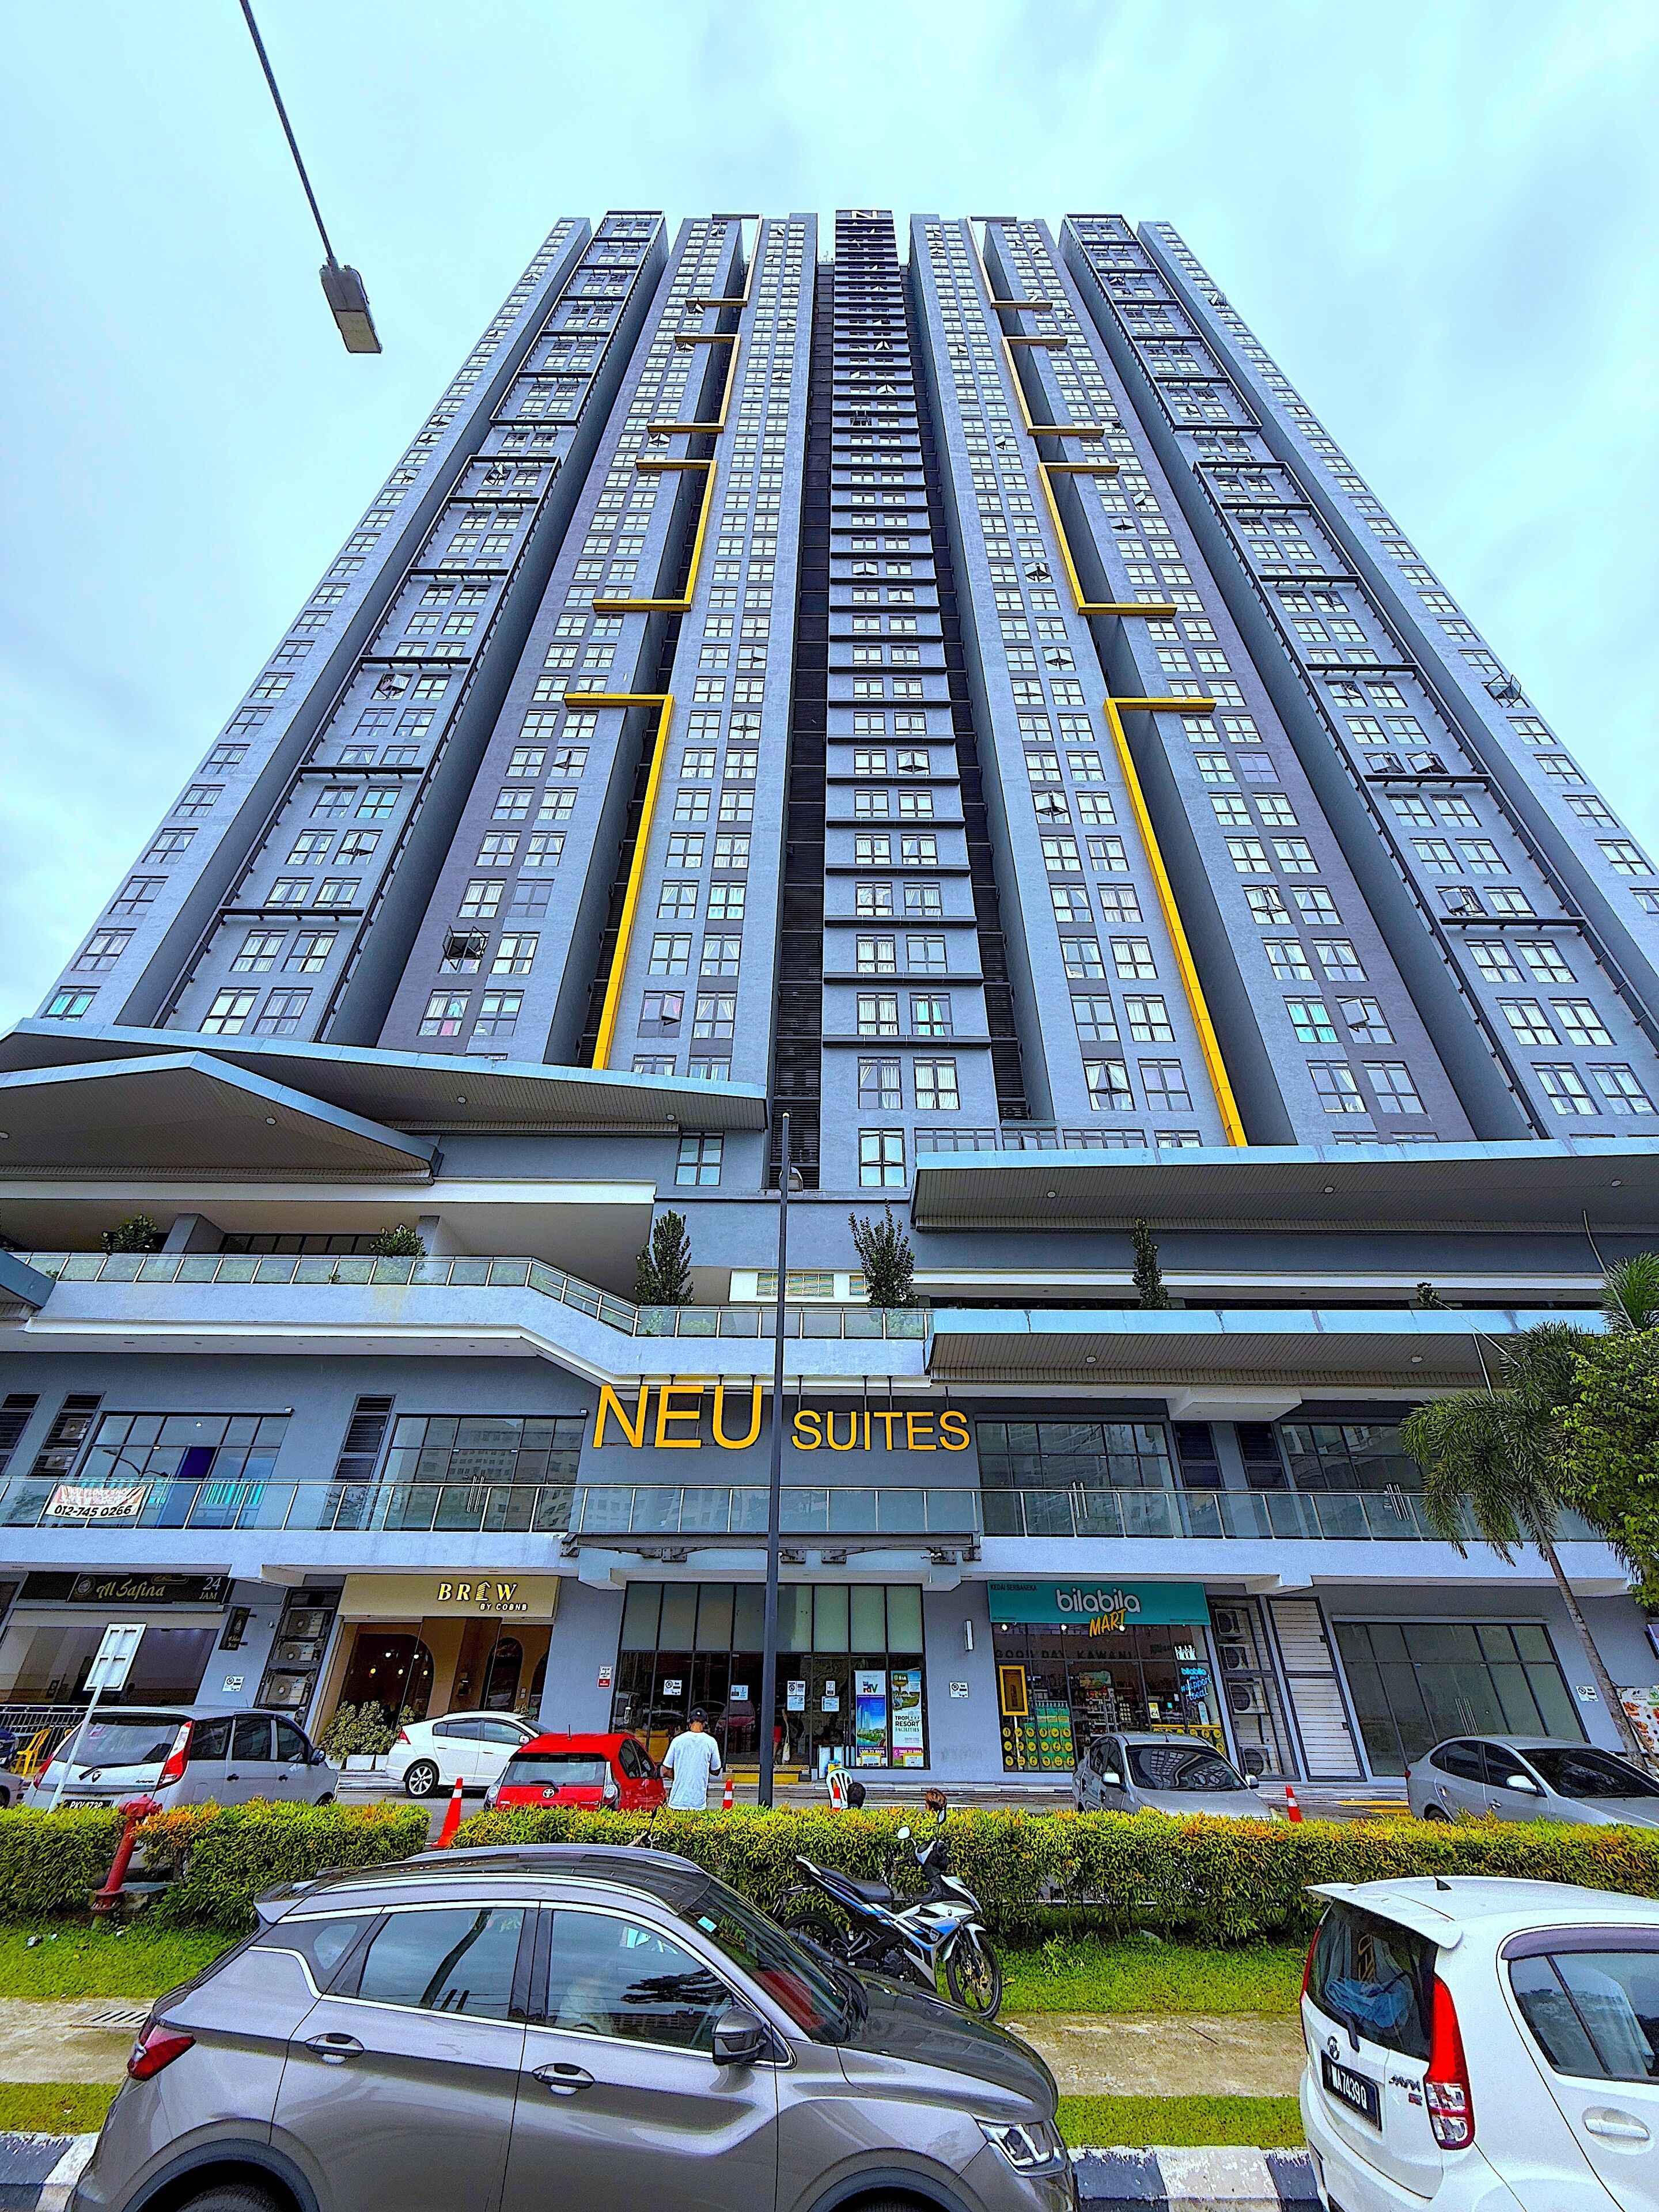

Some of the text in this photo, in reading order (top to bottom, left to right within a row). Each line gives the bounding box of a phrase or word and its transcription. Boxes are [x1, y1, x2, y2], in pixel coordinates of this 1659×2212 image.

[593, 1385, 970, 1450] NEU SUITES
[54, 1505, 132, 1516] 012-745 0266
[116, 1579, 166, 1600] Safina
[203, 1577, 221, 1590] 24
[437, 1581, 518, 1601] BREW
[199, 1592, 218, 1600] JAM
[1056, 1588, 1141, 1613] bilabila
[1089, 1608, 1127, 1637] MART
